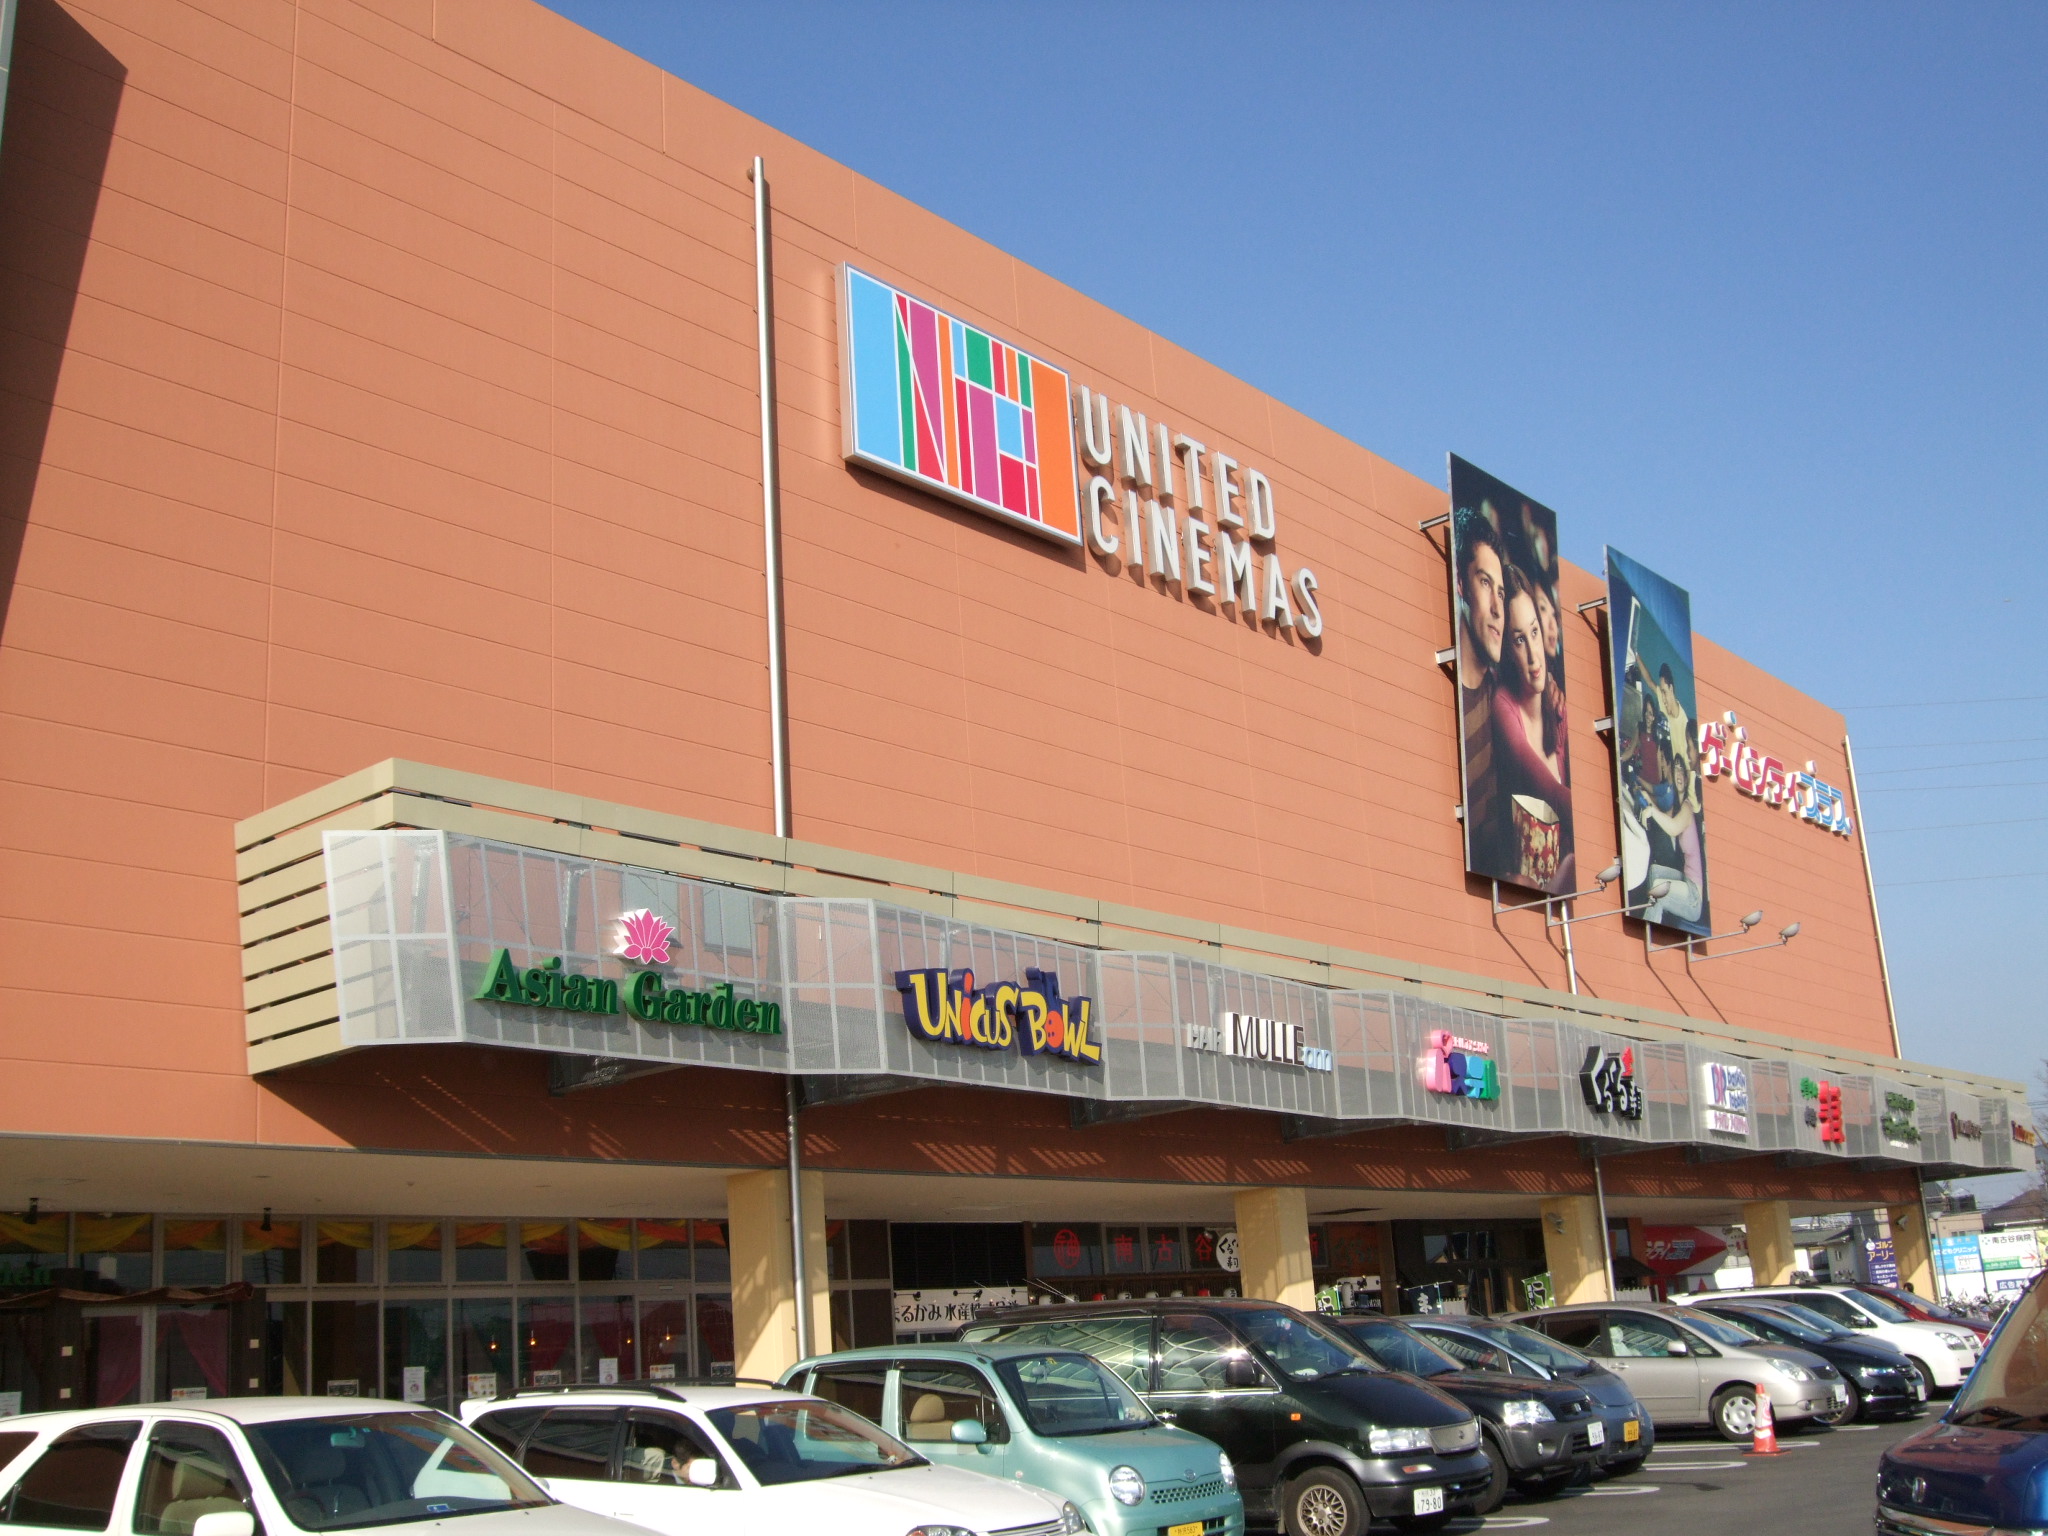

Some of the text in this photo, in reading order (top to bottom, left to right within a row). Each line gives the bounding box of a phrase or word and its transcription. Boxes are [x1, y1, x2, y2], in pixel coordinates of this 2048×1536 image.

[1075, 384, 1275, 541] UNITED
[1083, 475, 1322, 639] CINEMAS
[474, 948, 782, 1035] Asian Garden
[1225, 1012, 1304, 1066] MULLE
[1992, 1234, 2031, 1244] 南古谷病院
[1421, 1497, 1442, 1512] 79-80
